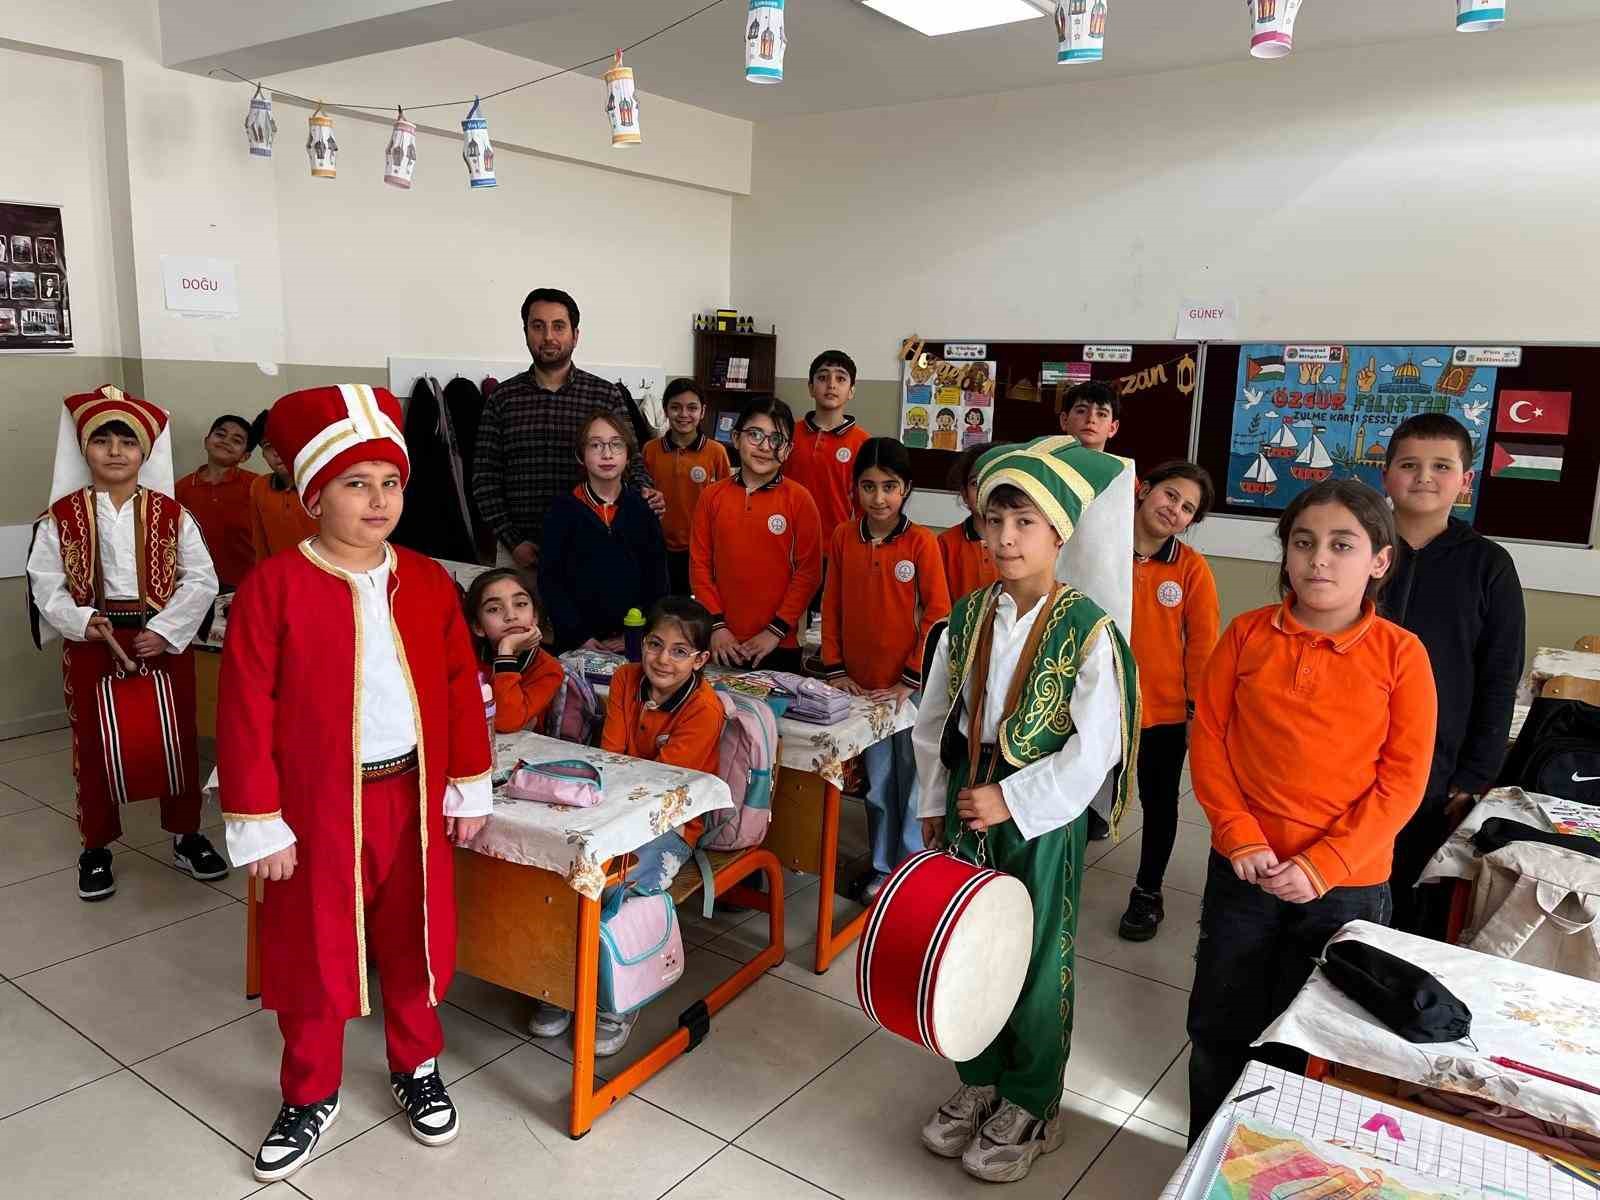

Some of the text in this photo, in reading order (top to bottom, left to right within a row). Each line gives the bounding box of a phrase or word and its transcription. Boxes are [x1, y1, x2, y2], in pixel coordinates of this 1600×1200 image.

[182, 277, 218, 291] DOĞU
[1189, 306, 1224, 319] GÜNEY
[1119, 363, 1168, 395] zan
